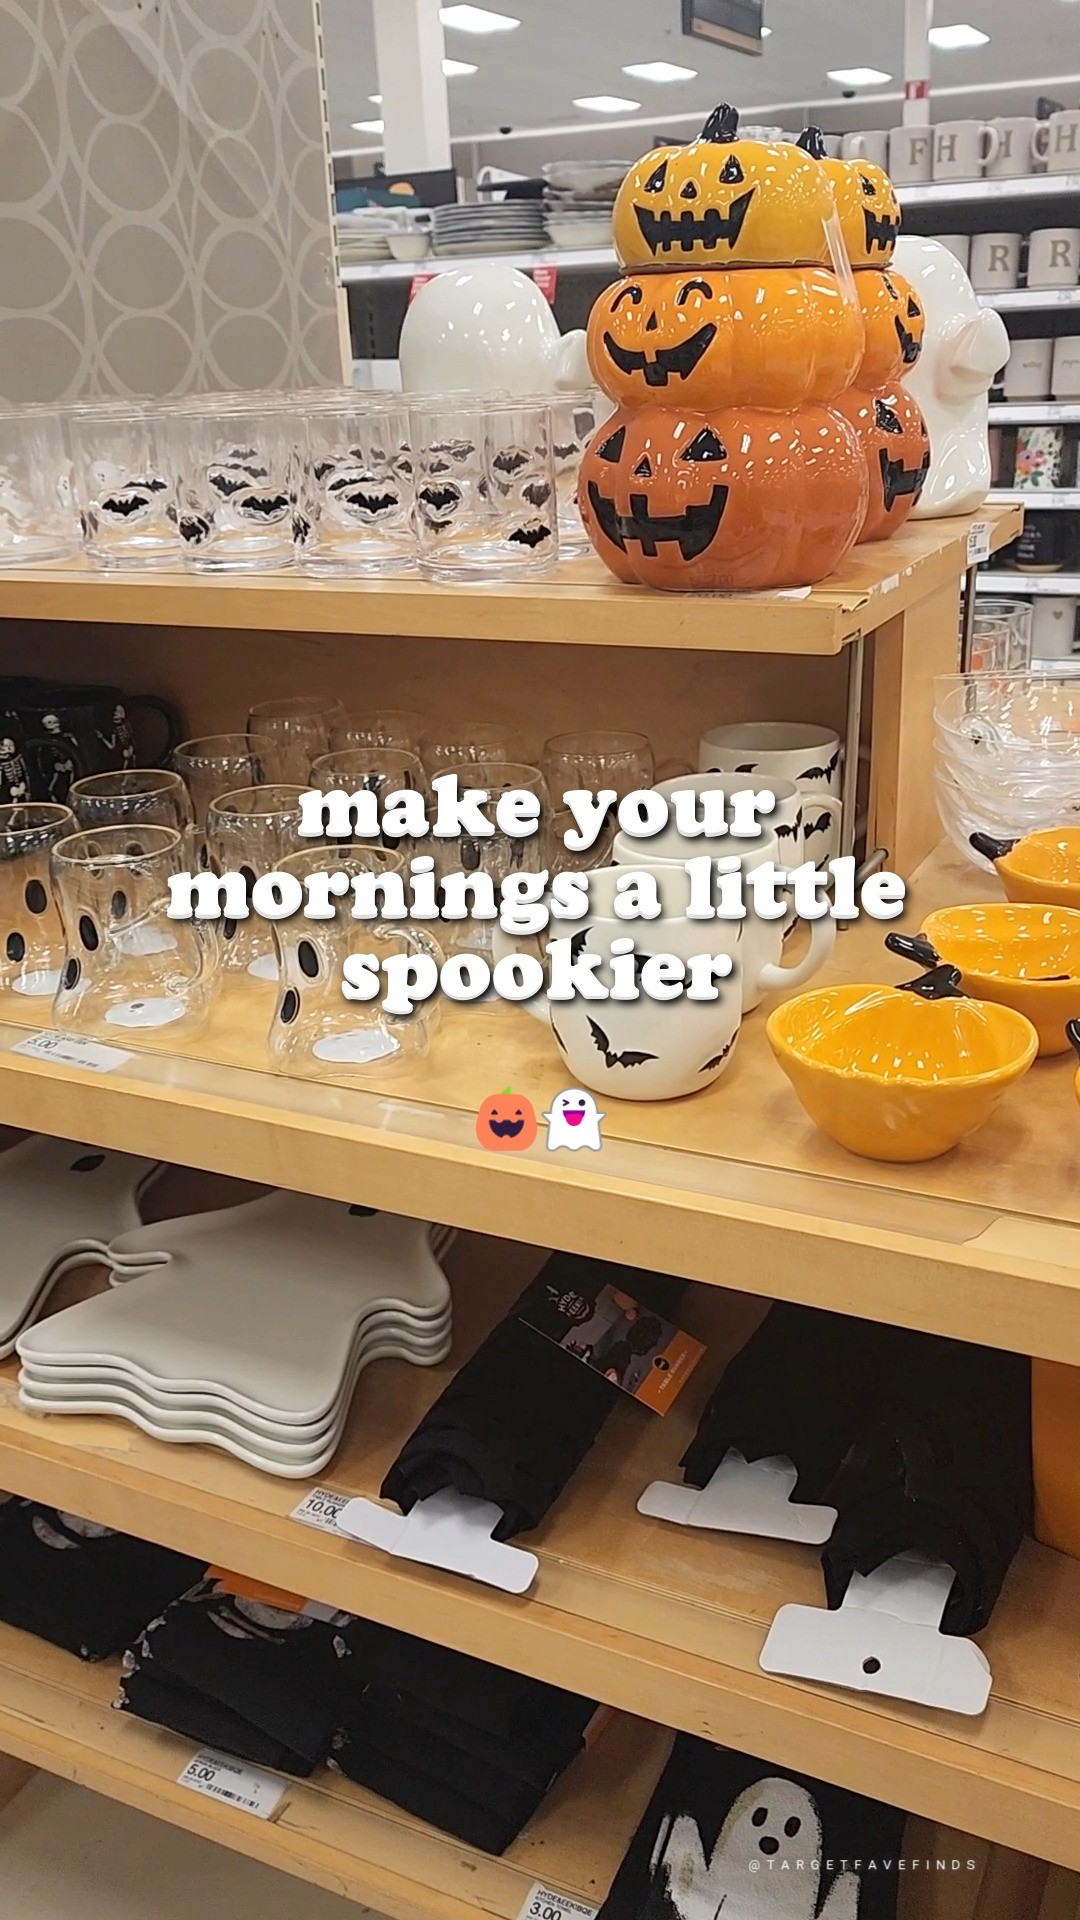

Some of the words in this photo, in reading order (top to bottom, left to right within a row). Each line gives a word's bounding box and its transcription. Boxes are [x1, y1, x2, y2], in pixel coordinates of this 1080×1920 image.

[909, 138, 928, 165] F
[936, 134, 958, 163] H
[1055, 123, 1079, 153] H
[988, 245, 1010, 272] R
[1049, 240, 1071, 268] R
[187, 1763, 216, 1782] 5.00
[529, 1902, 562, 1920] 3.00
